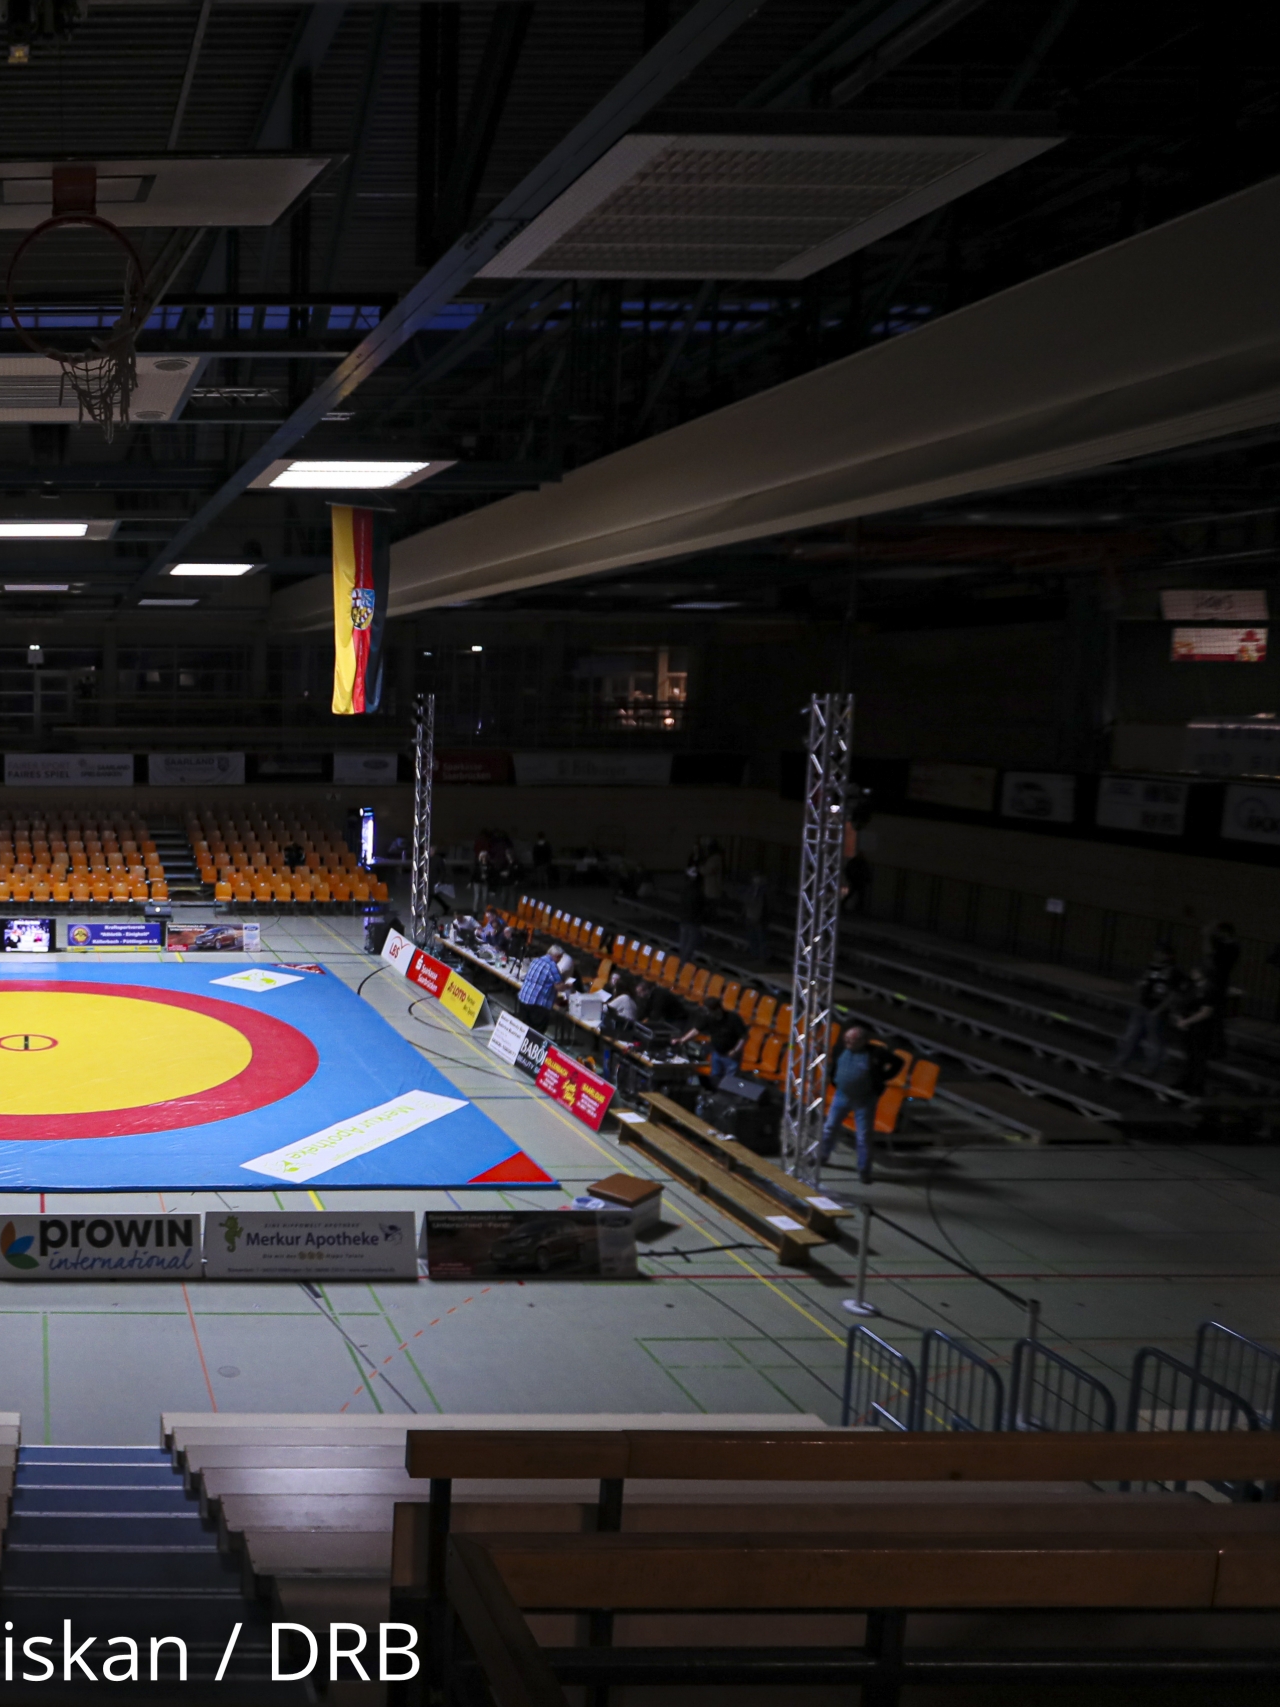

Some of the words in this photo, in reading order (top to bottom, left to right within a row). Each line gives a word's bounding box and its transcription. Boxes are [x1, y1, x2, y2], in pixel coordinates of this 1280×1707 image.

[164, 757, 215, 766] SAARLAND
[442, 762, 483, 772] Sparkasse
[7, 770, 42, 779] FAIRES
[44, 770, 70, 779] SPIEL
[442, 771, 492, 781] Saarbrücken
[389, 942, 401, 959] LBS
[421, 964, 438, 981] Sparkasse
[417, 974, 438, 993] Saarbrücken
[452, 987, 467, 1003] LOTTO
[360, 1104, 415, 1129] Merkur
[285, 1125, 365, 1160] Apotheke
[246, 1232, 301, 1247] Merkur
[304, 1231, 379, 1249] Apotheke
[48, 1248, 195, 1271] international
